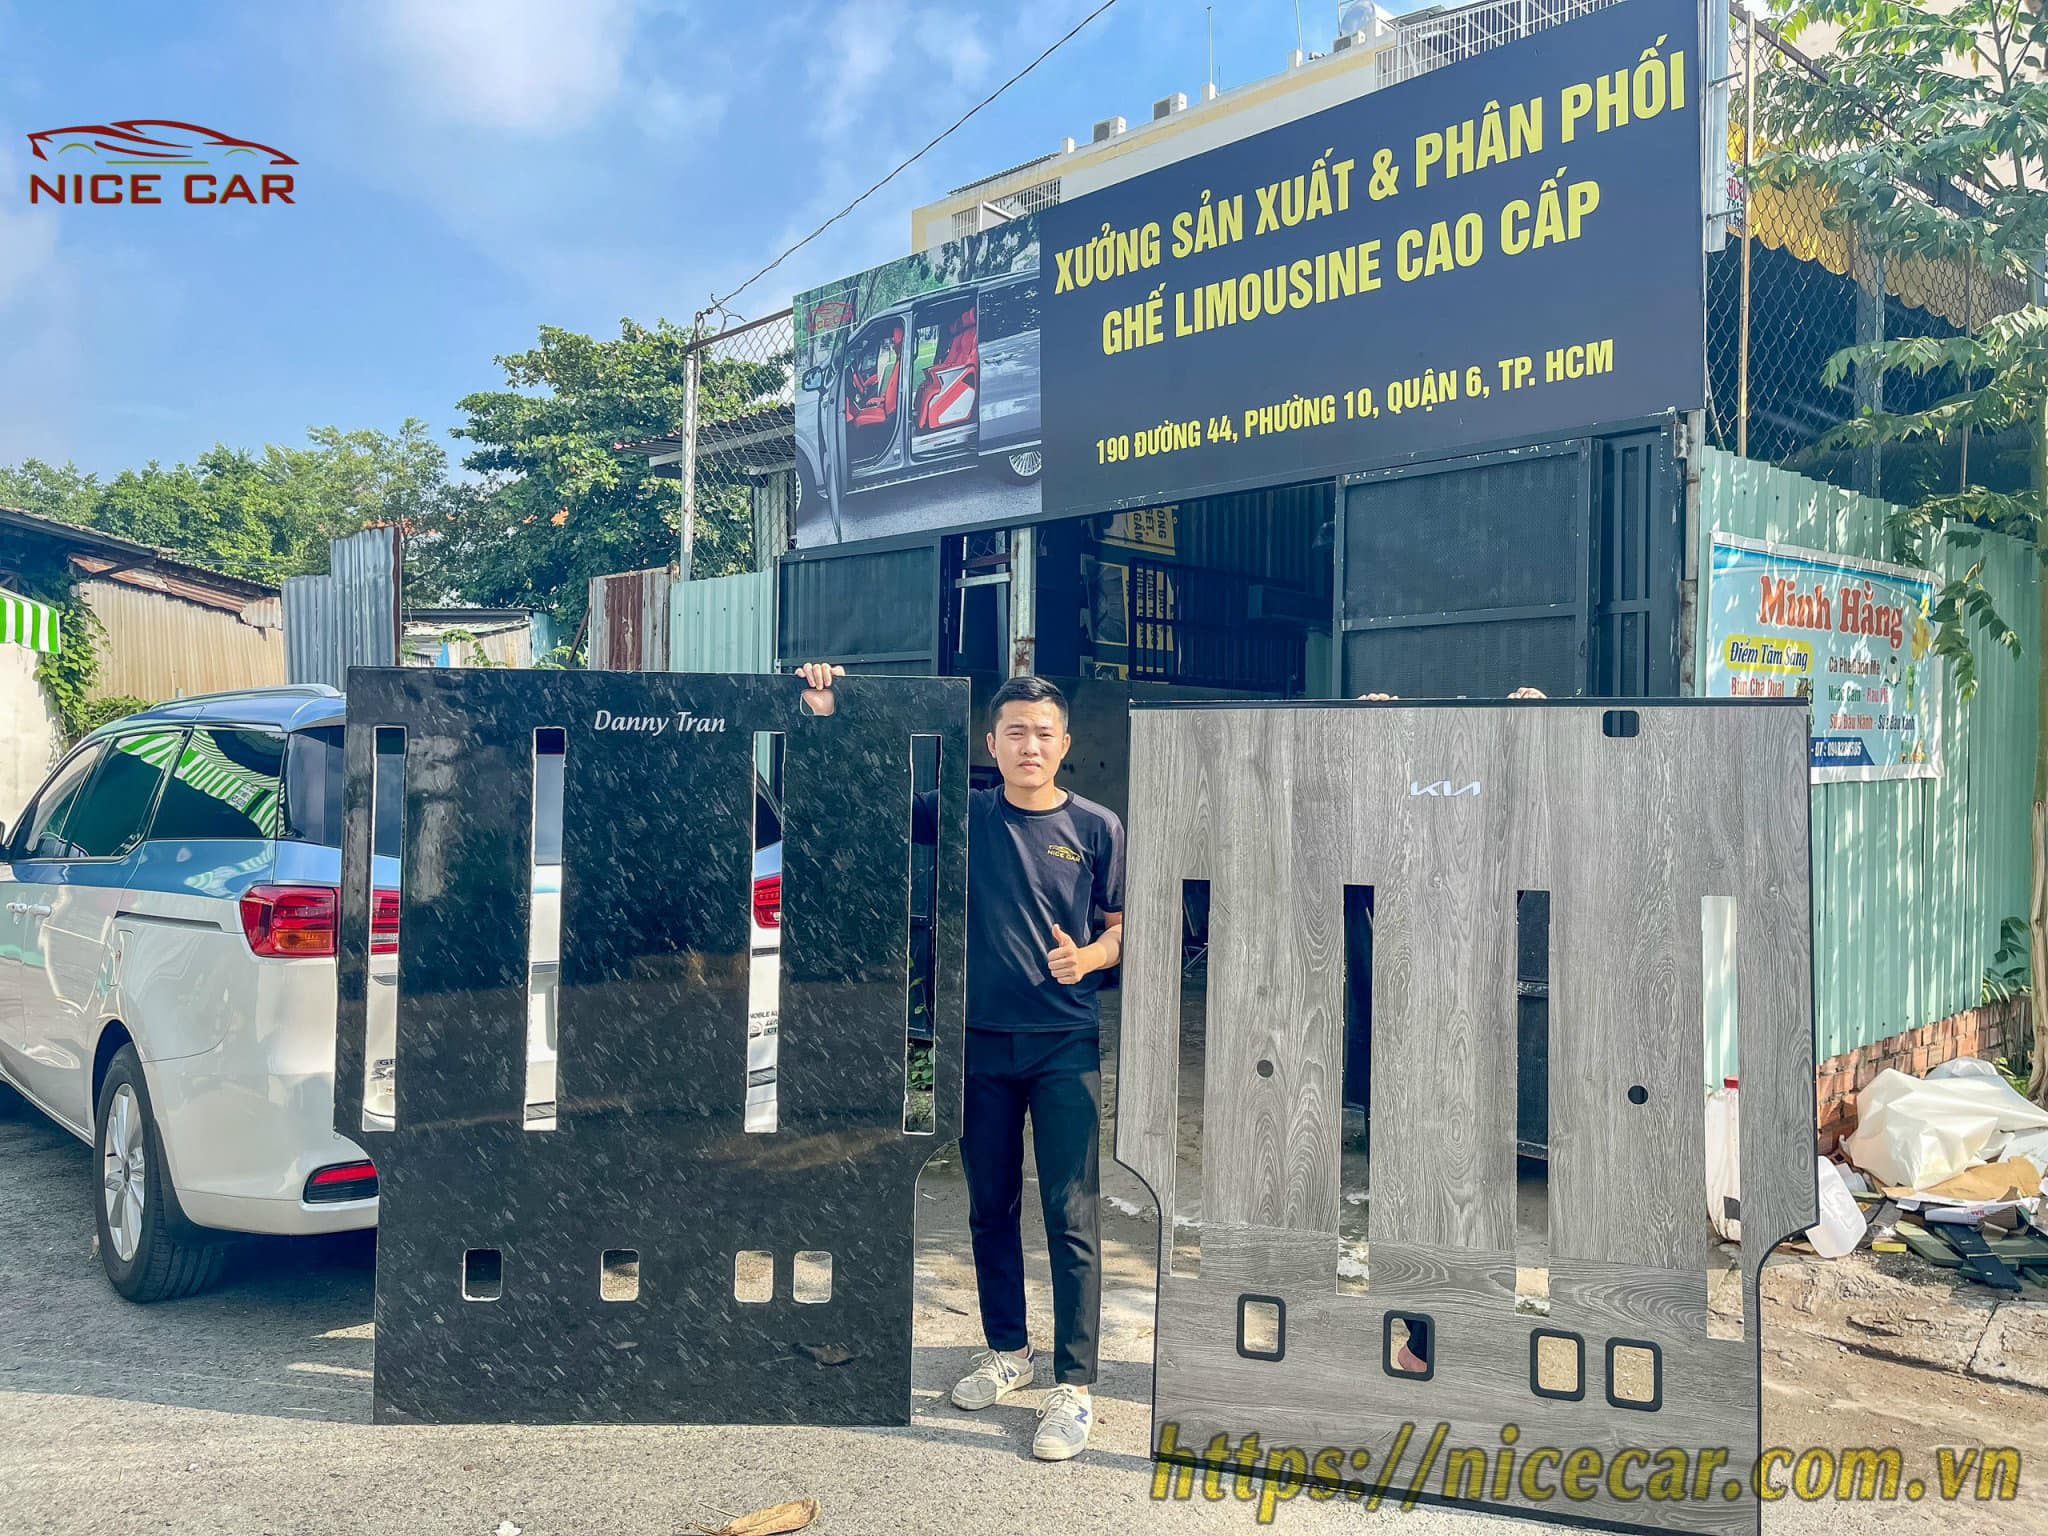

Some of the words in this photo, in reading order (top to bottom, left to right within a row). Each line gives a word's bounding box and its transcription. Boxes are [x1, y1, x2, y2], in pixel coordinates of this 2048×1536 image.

[1056, 222, 1161, 294] XƯỞNG
[1173, 190, 1243, 260] SẢN
[1256, 147, 1356, 236] XUẤT
[1369, 148, 1400, 201] &
[1416, 101, 1543, 189] PHÂN
[1561, 34, 1686, 143] PHỐI
[1102, 283, 1164, 356] GHẾ
[1175, 239, 1382, 338] LIMOUSINE
[1397, 213, 1484, 283] CAO
[1499, 167, 1602, 257] CẤP
[1096, 440, 1130, 465] 190
[1133, 416, 1202, 459] ĐƯỜNG
[1206, 416, 1239, 446] 44,
[1244, 391, 1338, 440] PHƯỜNG
[1343, 392, 1381, 424] 10,
[1387, 368, 1458, 414] QUẬN
[1465, 367, 1490, 398] 6,
[1498, 357, 1535, 392] TP.
[1545, 339, 1615, 385] HCM
[1760, 574, 1832, 631] Minh
[1839, 580, 1904, 649] Hằng
[594, 709, 669, 736] Danny
[677, 710, 726, 733] Tran
